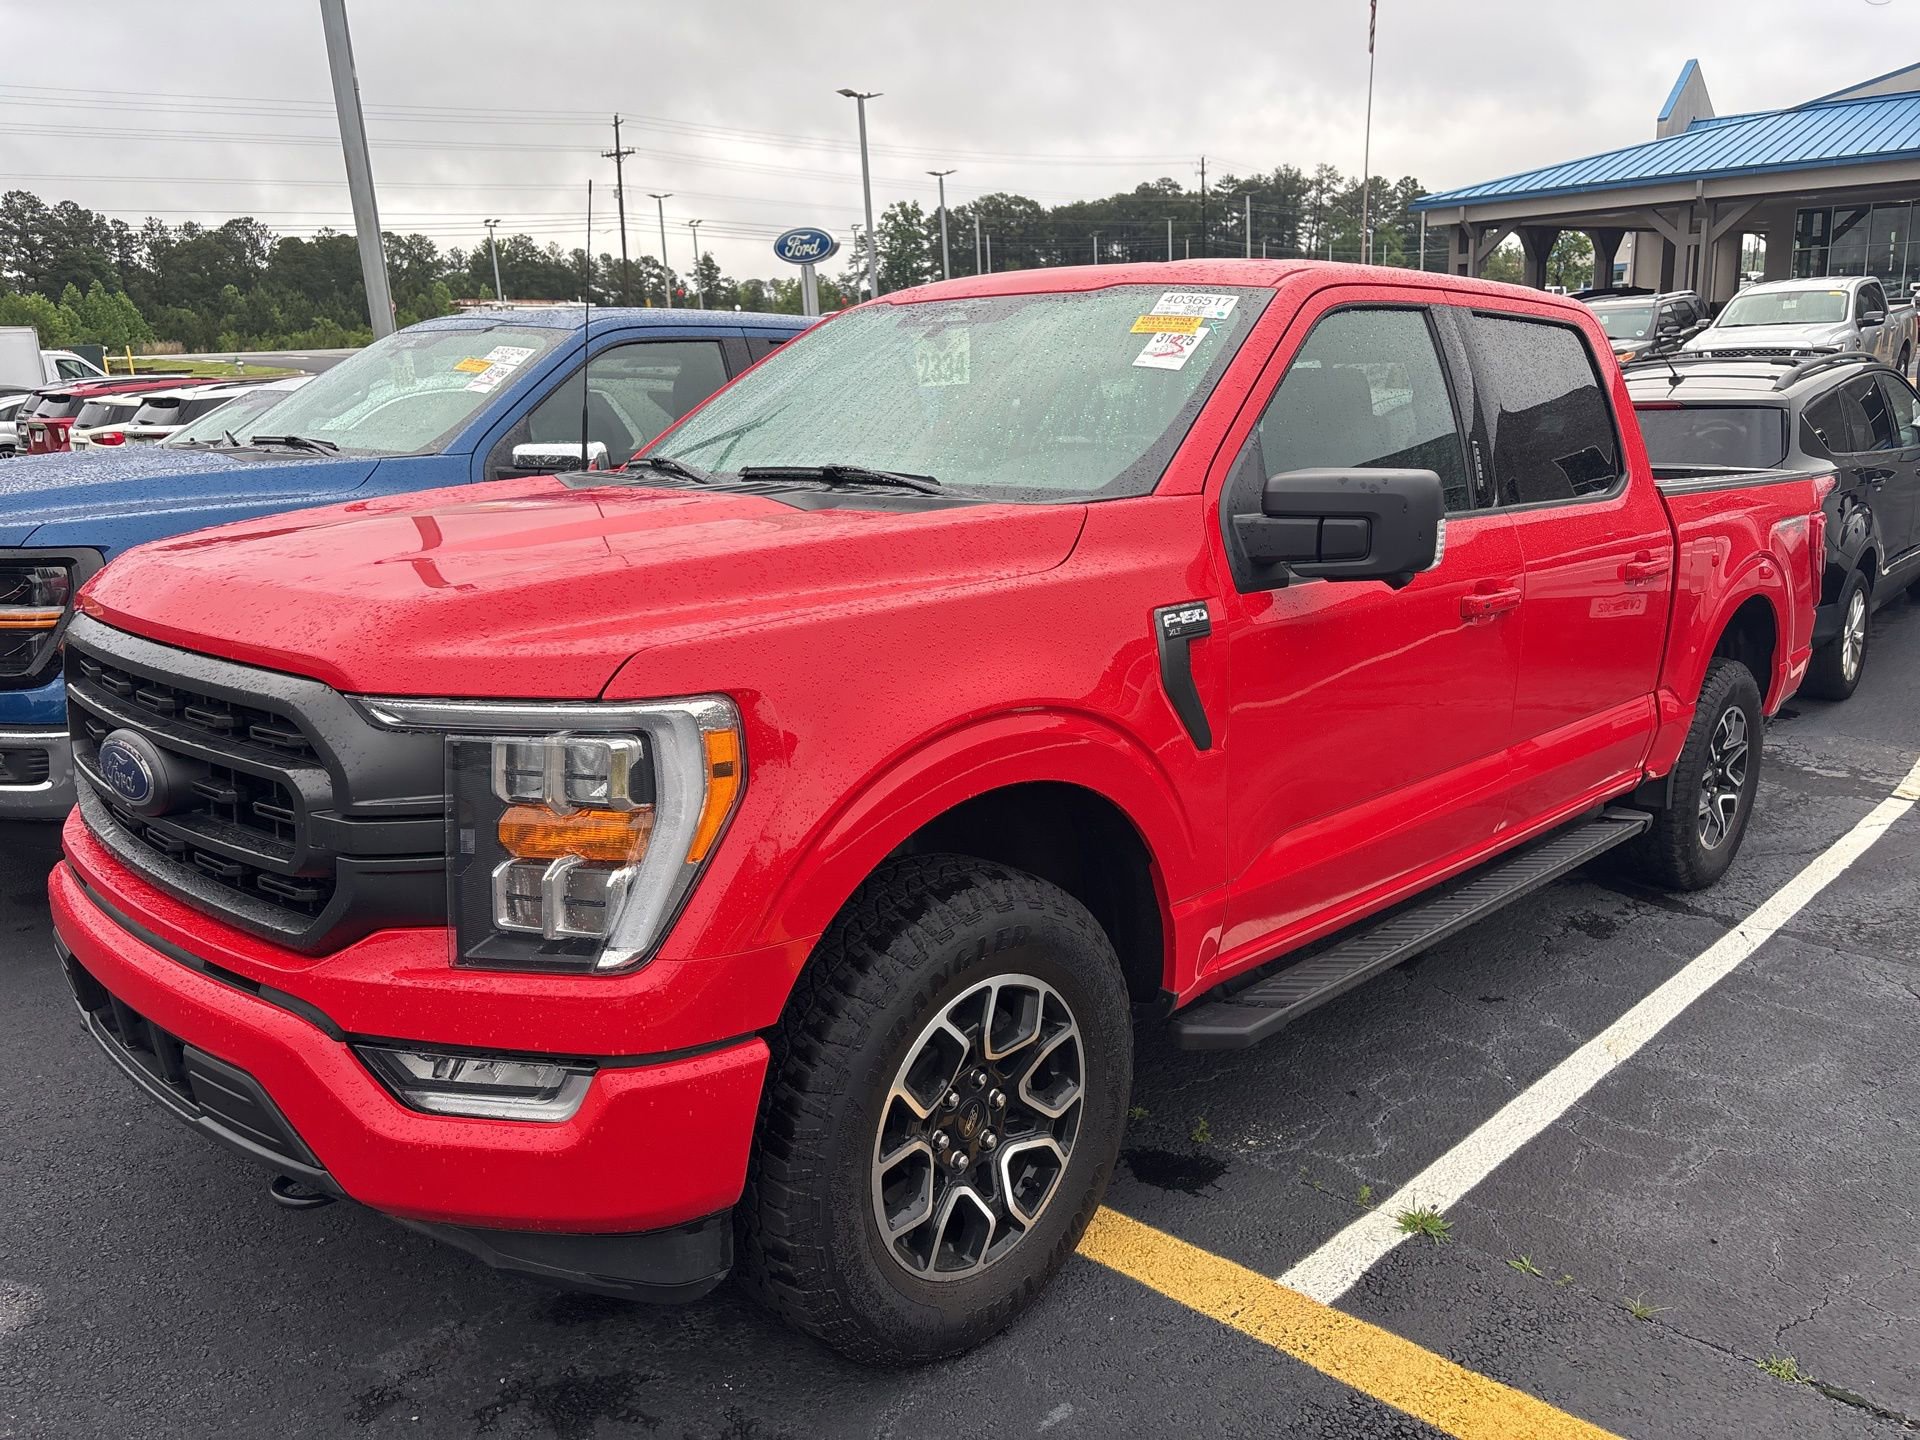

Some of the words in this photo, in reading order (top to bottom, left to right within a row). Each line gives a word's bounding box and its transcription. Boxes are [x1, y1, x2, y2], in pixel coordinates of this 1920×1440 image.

[784, 234, 821, 257] Ford
[1164, 295, 1234, 307] 4036517
[1163, 609, 1208, 627] F-150
[1169, 628, 1181, 636] XLT
[107, 752, 136, 793] Ford
